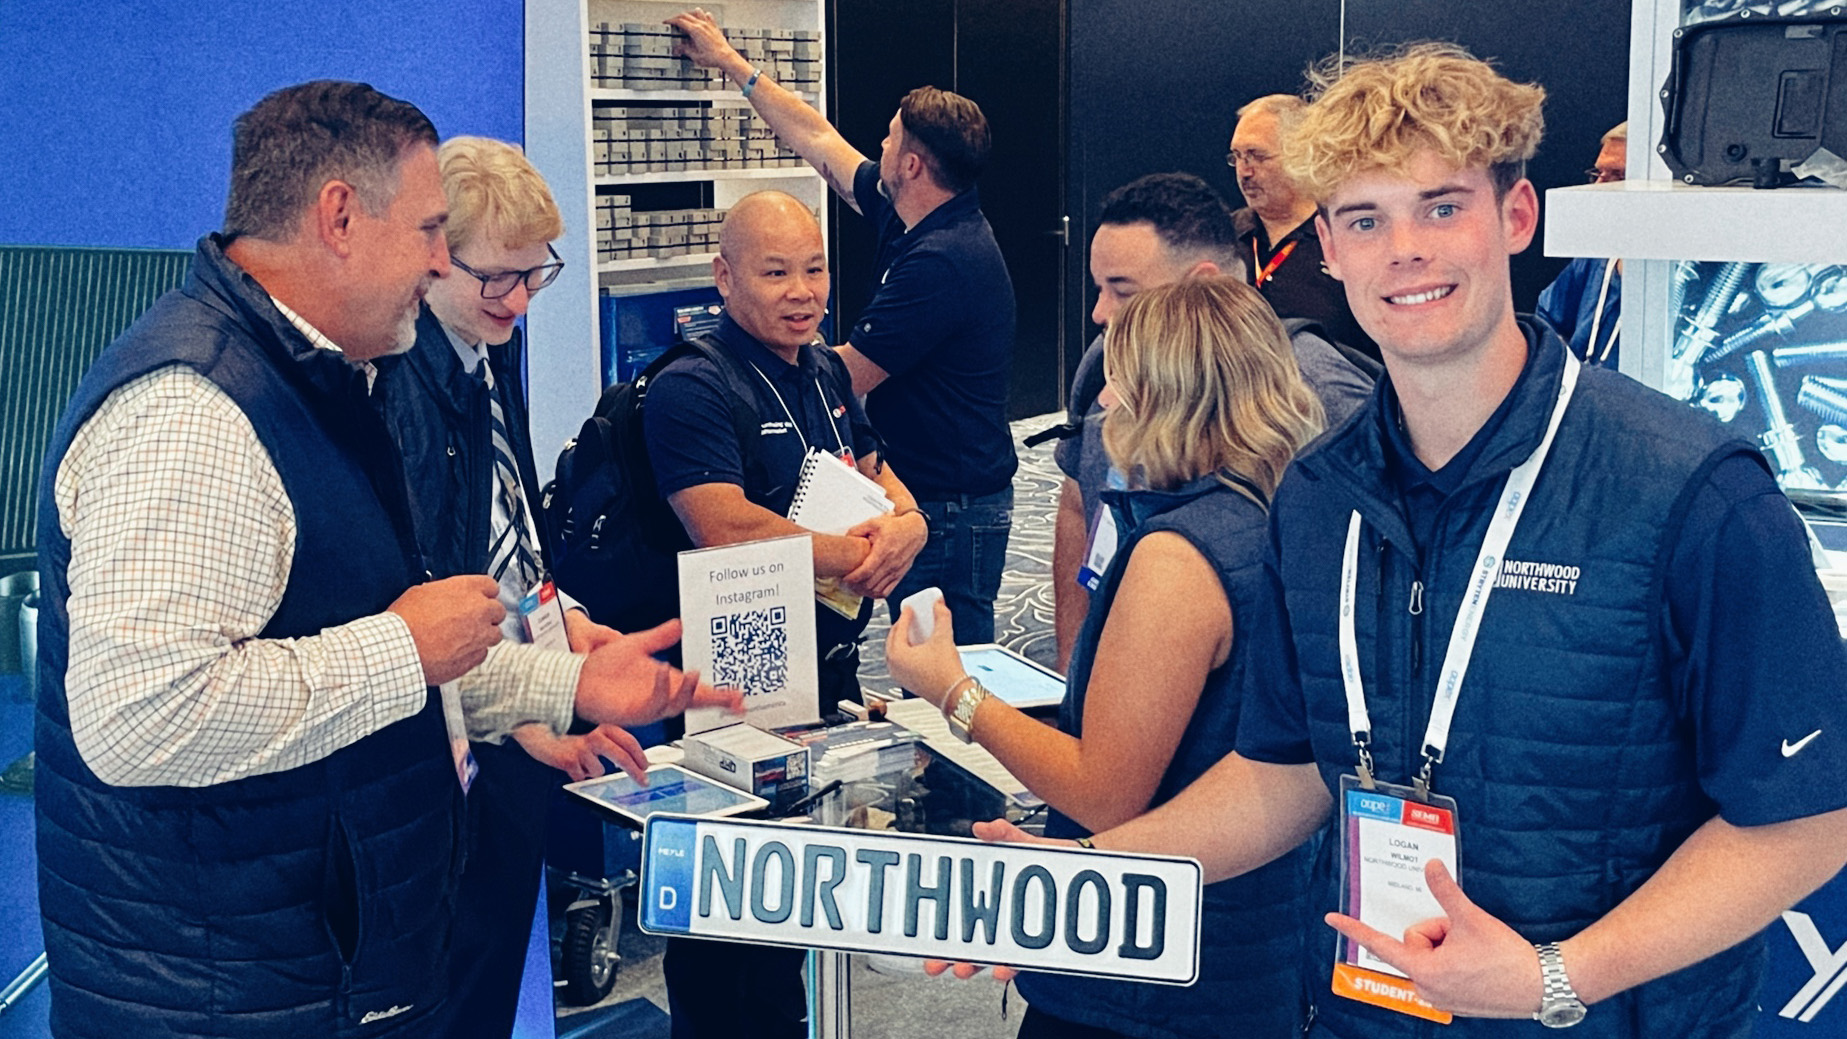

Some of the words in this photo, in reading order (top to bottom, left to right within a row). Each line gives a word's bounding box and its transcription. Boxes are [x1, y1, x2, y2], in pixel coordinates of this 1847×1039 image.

[709, 567, 748, 583] Follow
[752, 565, 766, 577] us
[769, 562, 784, 574] on
[1504, 560, 1580, 580] NORTHWOOD
[716, 584, 780, 605] Instagram!
[1501, 575, 1577, 595] UNIVERSITY
[1389, 838, 1419, 851] LOGAN
[1391, 852, 1418, 863] WILMOT
[659, 886, 677, 910] D
[699, 834, 1168, 961] NORTHWOOD
